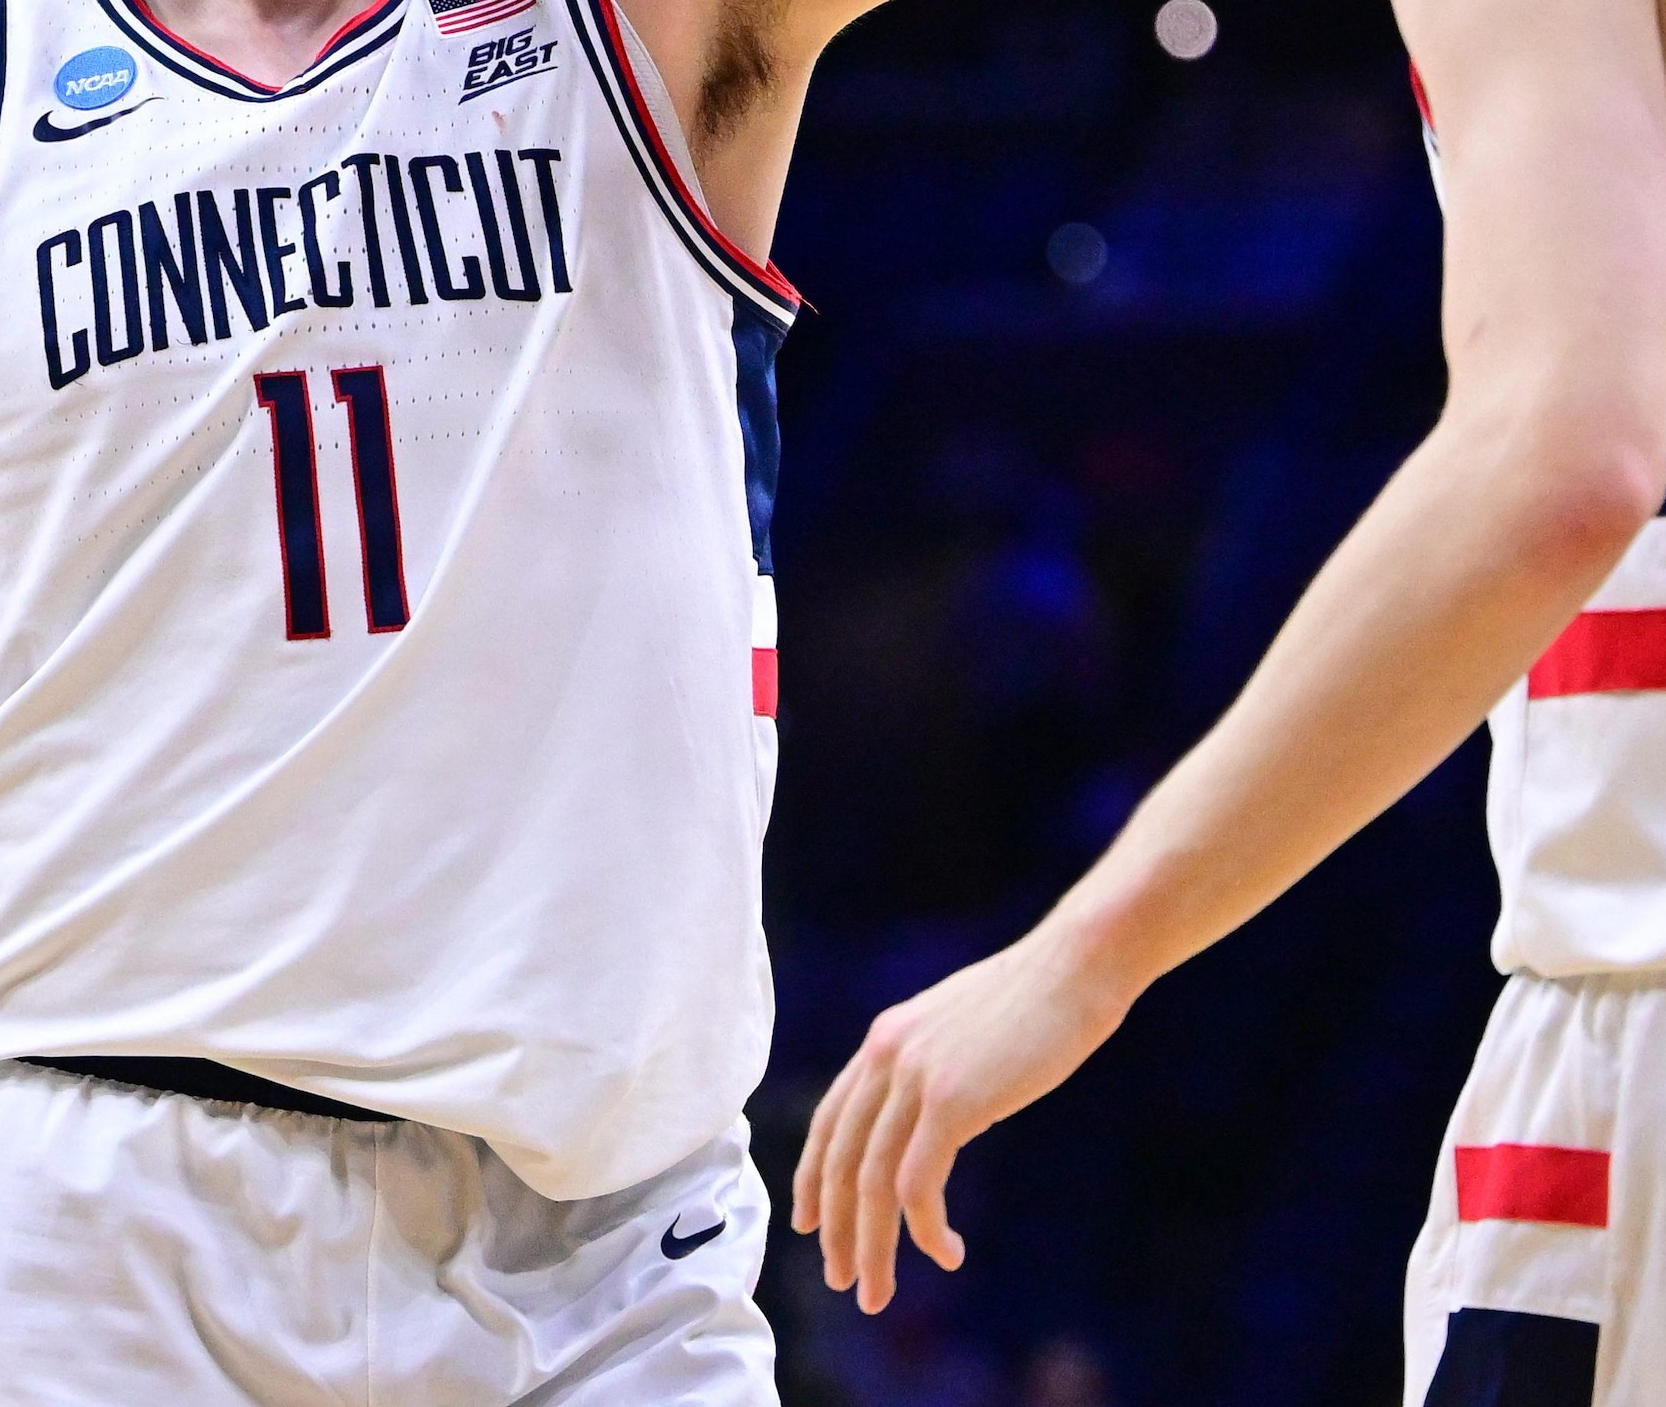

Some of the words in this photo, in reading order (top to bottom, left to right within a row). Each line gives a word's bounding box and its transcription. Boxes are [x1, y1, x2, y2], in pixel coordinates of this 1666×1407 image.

[463, 40, 558, 90] EAST
[468, 25, 536, 69] BIG
[65, 68, 130, 97] NCAA
[35, 148, 573, 390] CONNECTICUT
[253, 365, 411, 641] 11
